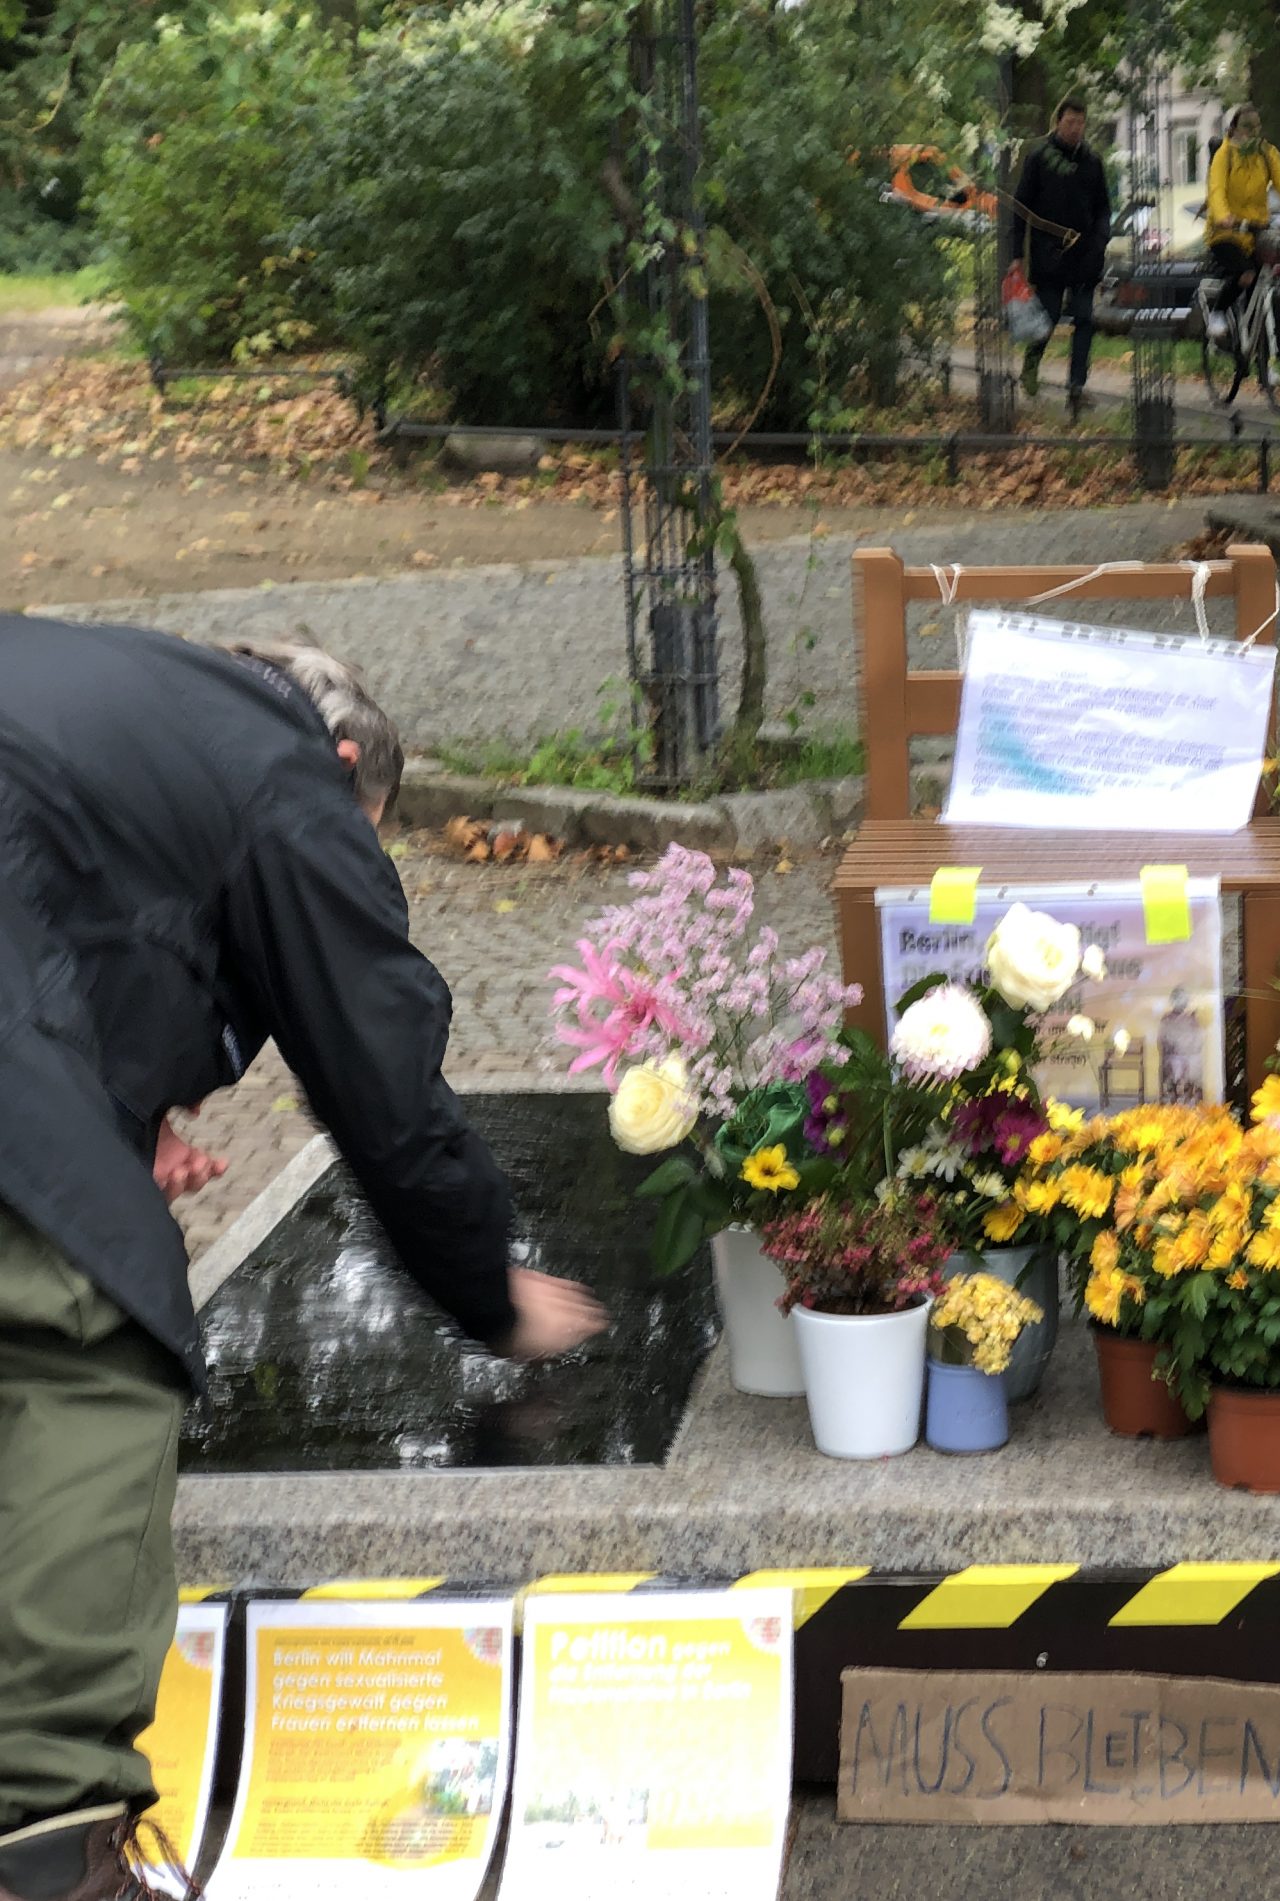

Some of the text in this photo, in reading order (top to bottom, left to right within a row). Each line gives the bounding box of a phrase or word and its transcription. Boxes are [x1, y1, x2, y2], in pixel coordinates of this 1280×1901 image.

[551, 1629, 667, 1661] Petition
[273, 1647, 443, 1667] Berlin will Mahnmal
[273, 1669, 444, 1692] gegen sexualisierte
[272, 1691, 448, 1714] Kriegsgewalt gegen
[271, 1714, 331, 1732] Frauen
[424, 1713, 480, 1732] lassen
[852, 1696, 1016, 1799] MUSS
